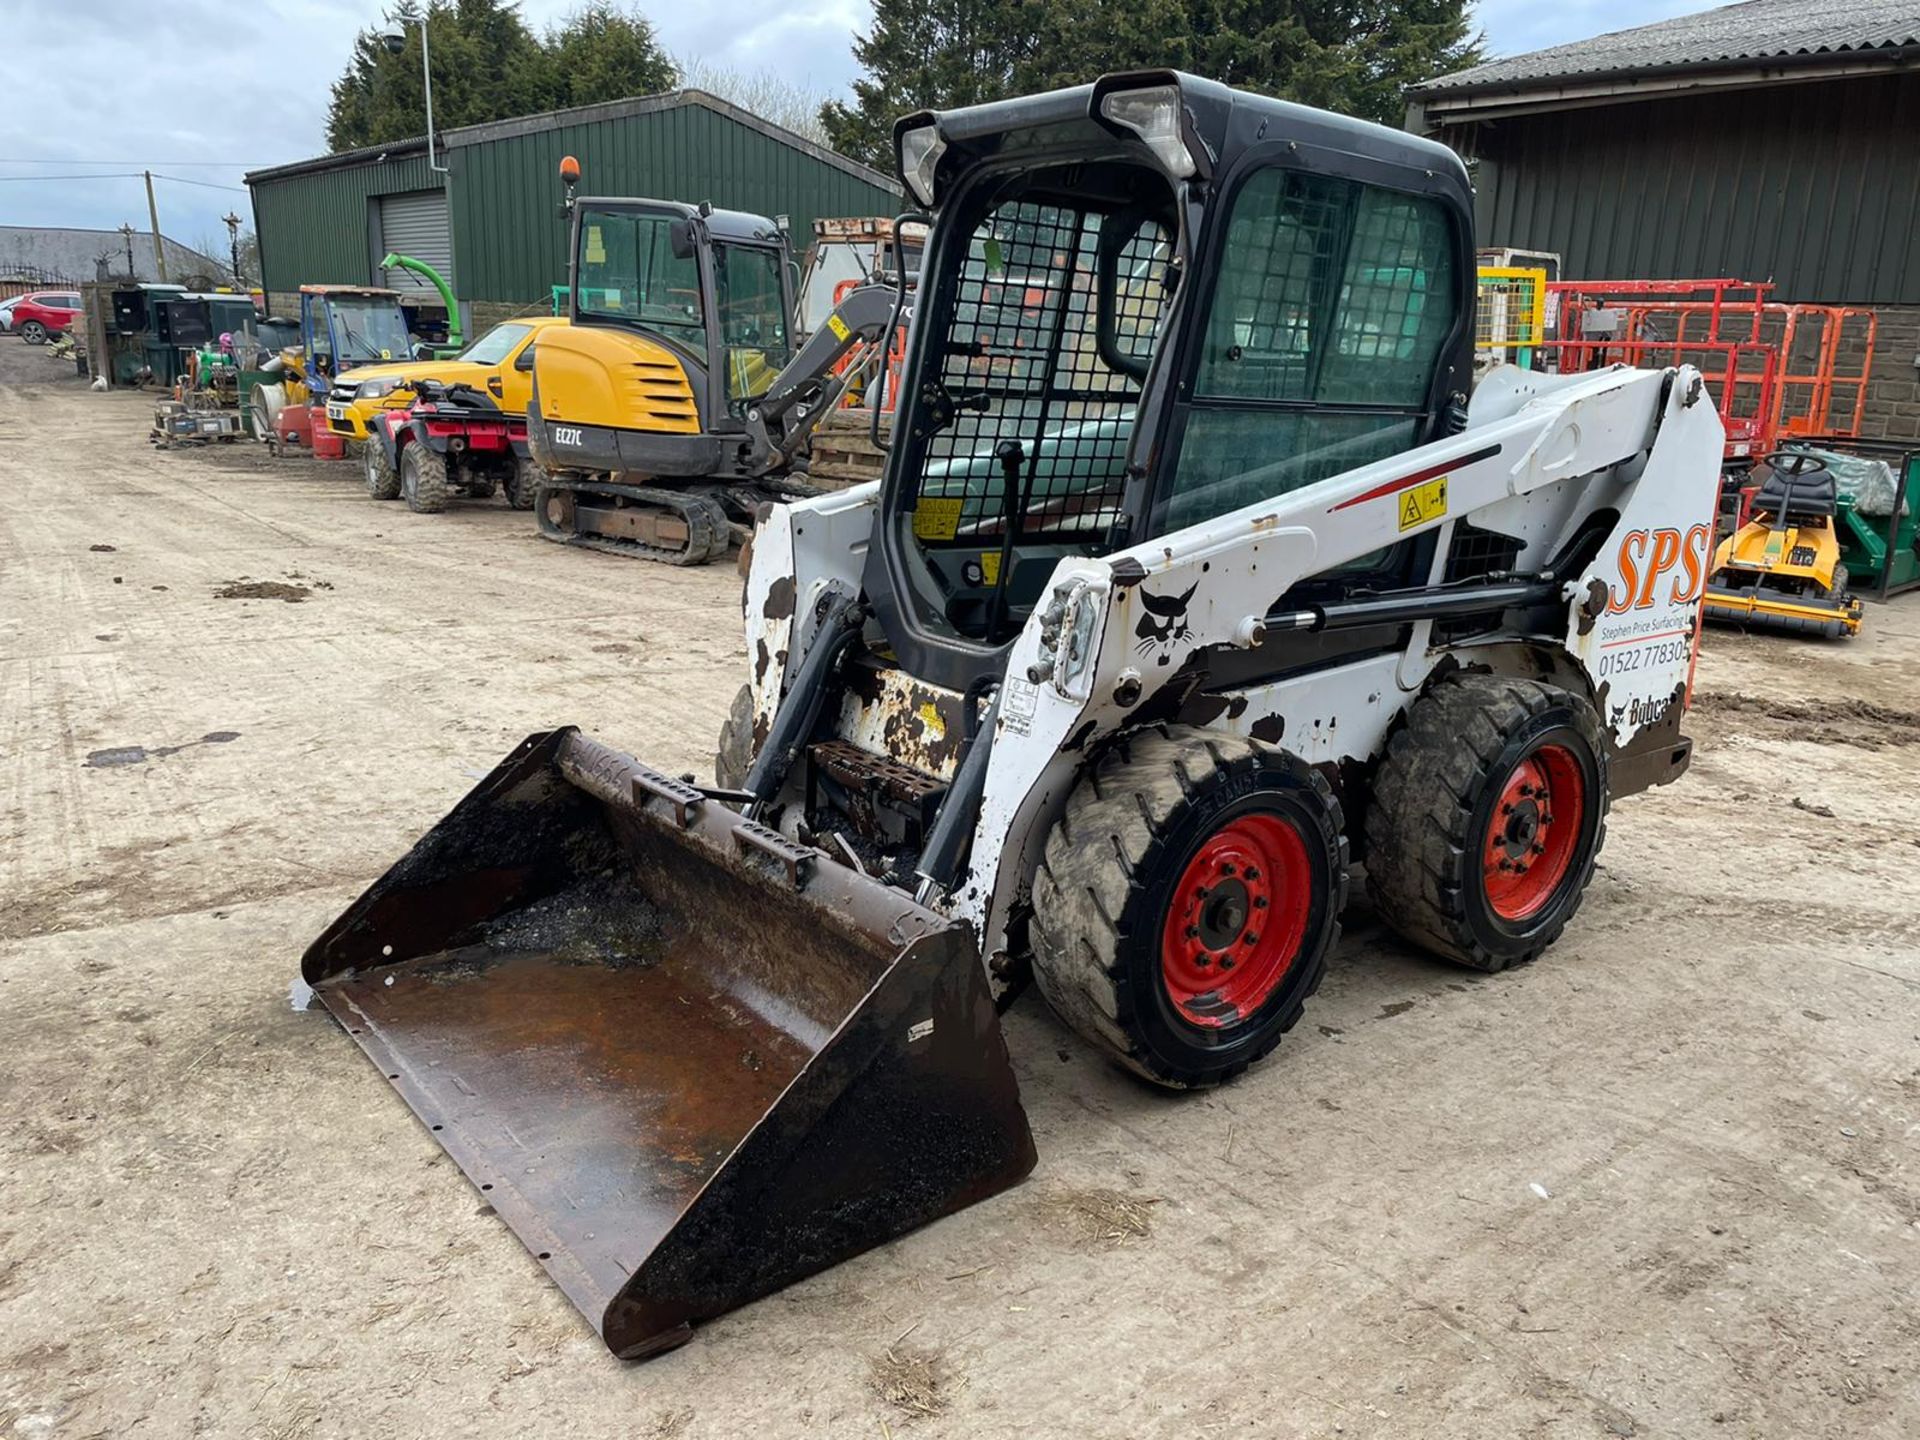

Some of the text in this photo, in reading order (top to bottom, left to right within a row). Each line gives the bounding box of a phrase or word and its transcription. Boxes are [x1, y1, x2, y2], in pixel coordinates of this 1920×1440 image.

[556, 427, 582, 446] EC27C
[1604, 522, 1711, 617] SPS
[1602, 625, 1632, 641] Stephen
[1633, 620, 1651, 634] Price
[1652, 615, 1685, 632] Surfacing
[1599, 649, 1641, 677] 01522
[1628, 693, 1672, 727] Bobca
